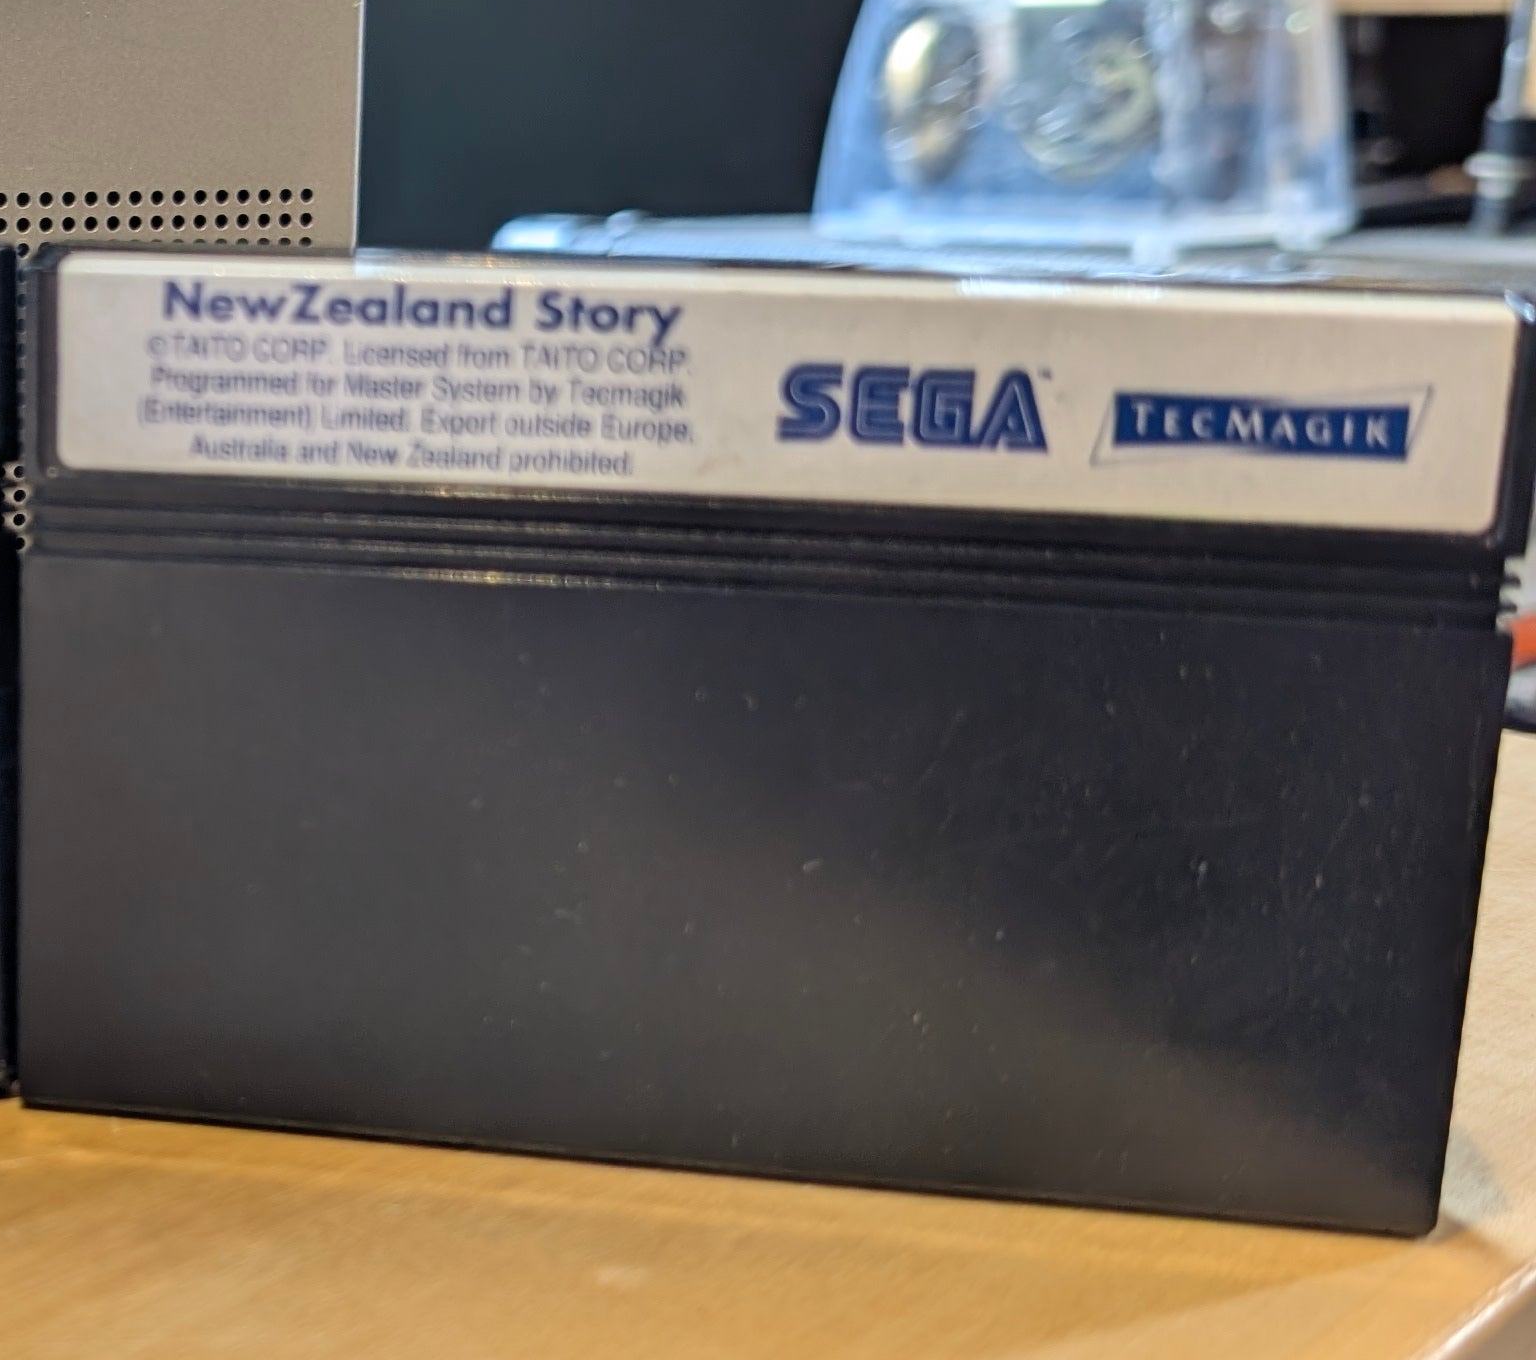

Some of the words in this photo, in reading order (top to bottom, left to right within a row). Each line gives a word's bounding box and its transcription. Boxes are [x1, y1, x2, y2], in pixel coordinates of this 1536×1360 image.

[534, 289, 683, 349] Story
[343, 338, 449, 370] Licensed
[457, 343, 511, 370] from
[521, 344, 599, 373] TAITO
[150, 365, 299, 398] Programmed
[307, 371, 338, 397] for
[344, 372, 423, 400] Master
[431, 376, 521, 406] System
[529, 378, 559, 407] by
[567, 379, 686, 414] Tecmagik
[776, 362, 1049, 454] SEGA
[420, 407, 498, 438] Export
[505, 412, 593, 439] outside
[190, 434, 289, 463] Australia
[296, 440, 338, 465] and
[346, 441, 400, 467] New
[406, 441, 502, 472] Zealand
